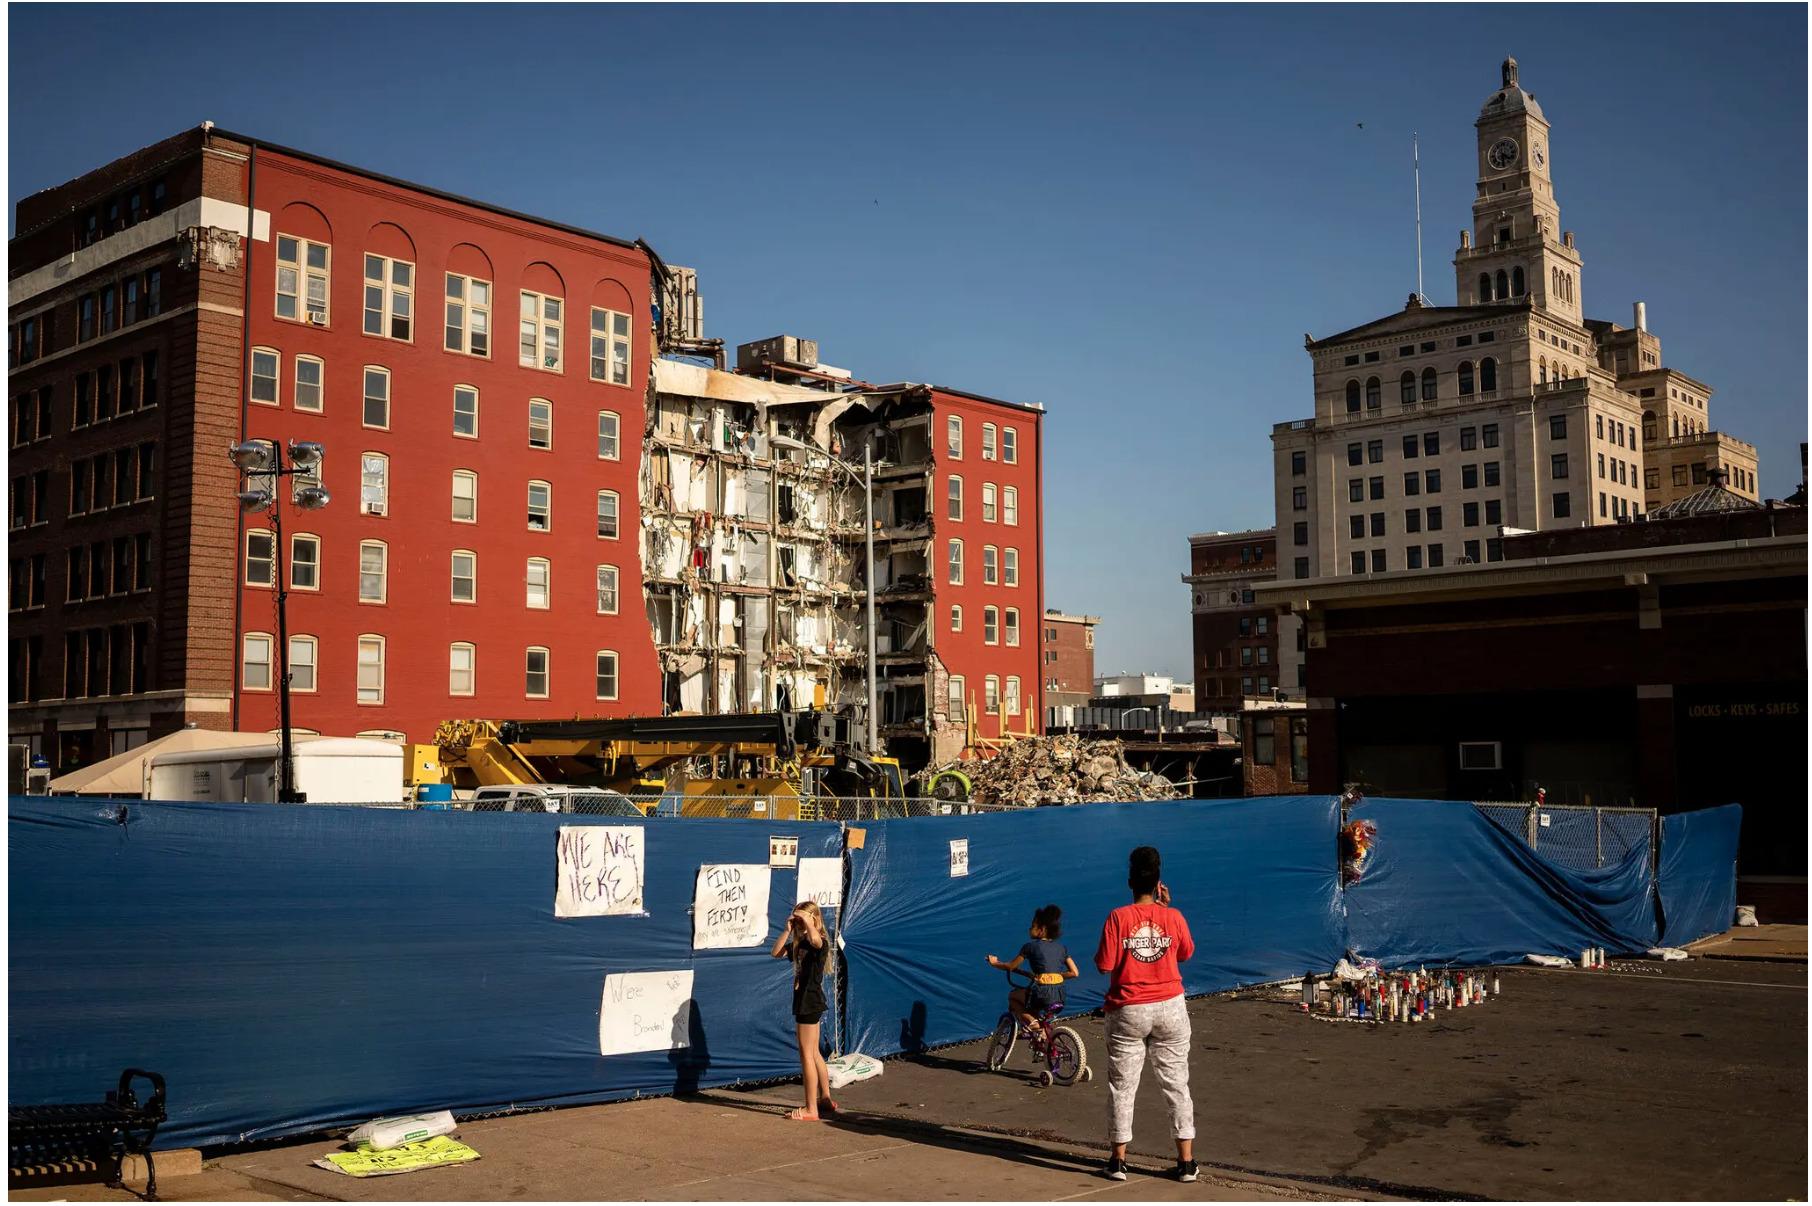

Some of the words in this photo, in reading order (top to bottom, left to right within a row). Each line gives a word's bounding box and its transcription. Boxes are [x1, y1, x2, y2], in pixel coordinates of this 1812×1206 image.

[1688, 704, 1721, 717] LOCKS
[1730, 703, 1757, 716] KEYS
[1766, 702, 1799, 716] SAFES
[561, 830, 593, 870] WE
[603, 831, 638, 866] ARE
[706, 866, 741, 889] FIND
[717, 884, 746, 904] THEM
[707, 905, 748, 927] FIRST!
